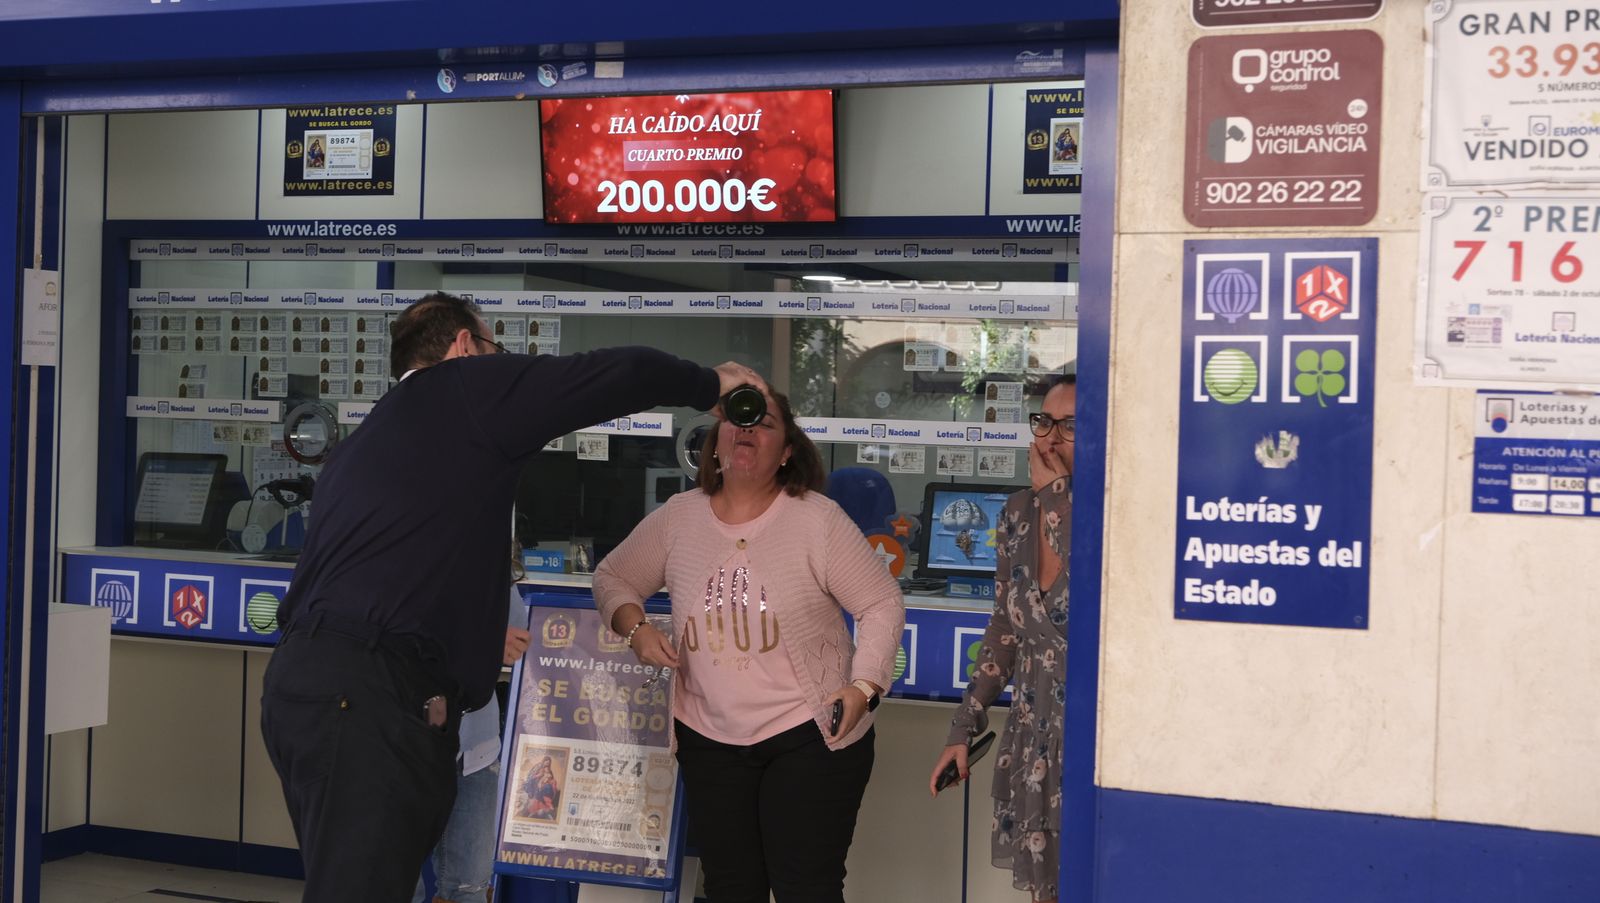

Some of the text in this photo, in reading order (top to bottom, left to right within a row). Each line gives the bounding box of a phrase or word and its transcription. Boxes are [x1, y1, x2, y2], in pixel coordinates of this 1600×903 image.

[1459, 8, 1600, 36] GRAN PR
[1270, 49, 1331, 68] grupo
[1270, 62, 1340, 83] control
[288, 106, 393, 118] www.latrece.es
[608, 109, 762, 136] HA CAÍDO AQUÍ
[1256, 121, 1368, 137] CÁMARAS VÍDEO
[330, 137, 355, 145] 89874
[1032, 135, 1043, 144] 13
[1256, 136, 1368, 154] VIGILANCIA
[628, 147, 742, 162] CUARTO PREMIO
[1464, 138, 1589, 161] VENDIDO
[285, 179, 392, 191] www.latrece.es
[1206, 180, 1362, 204] 902 26 22 22
[597, 178, 777, 213] 200.000€
[1473, 205, 1504, 232] 2º
[267, 221, 397, 236] www.latrece.es
[617, 223, 764, 236] www.latrece.es
[1487, 288, 1513, 296] Sorteo
[1515, 331, 1557, 343] Lotería
[170, 404, 195, 412] Nacional
[243, 406, 269, 415] Nacional
[1520, 402, 1588, 413] Loterías y
[632, 421, 661, 430] Nacional
[1520, 415, 1586, 426] Apuestas
[888, 427, 920, 437] Nacional
[984, 430, 1017, 440] Nacional
[1502, 446, 1567, 458] ATENCIÓN
[1569, 448, 1586, 458] AL
[1186, 496, 1322, 531] Loterías y
[1184, 537, 1362, 568] Apuestas del
[1184, 578, 1276, 606] Estado
[550, 624, 567, 638] 13
[538, 679, 666, 706] SE BUSCA
[532, 703, 666, 732] EL GORDO
[572, 754, 643, 778] 89874
